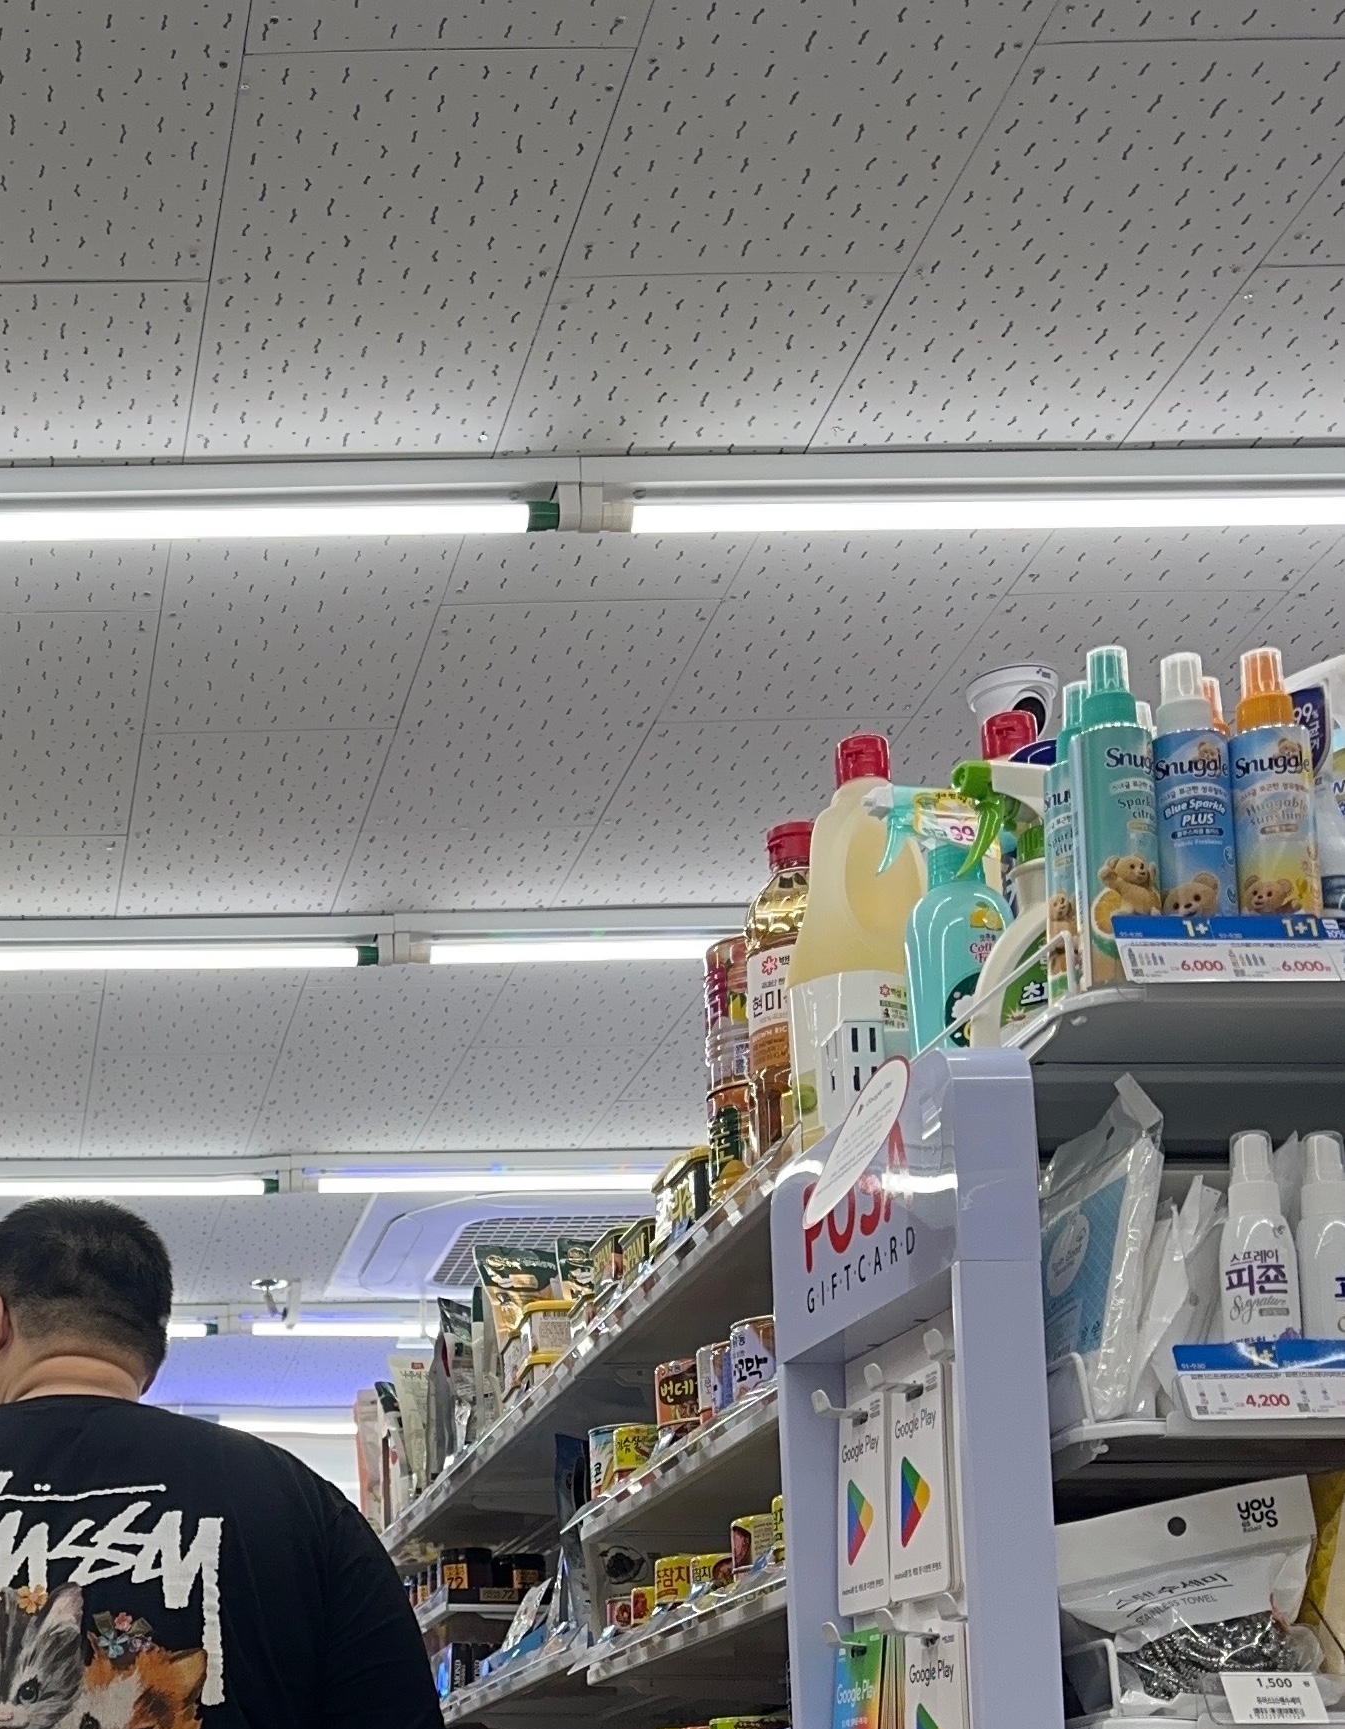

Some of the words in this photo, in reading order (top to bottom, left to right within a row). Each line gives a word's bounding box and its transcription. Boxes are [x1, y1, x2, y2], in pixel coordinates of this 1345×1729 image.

[1155, 749, 1229, 781] Snuggle
[1235, 749, 1310, 779] Snuggle
[1164, 801, 1189, 819] Blue
[1189, 799, 1226, 814] Sparkle
[1181, 812, 1215, 827] PLUS
[1282, 917, 1319, 938] 1+1
[1180, 959, 1224, 973] 6,000
[1281, 960, 1325, 973] 6,000
[1230, 1249, 1279, 1264] 스프레이
[1225, 1264, 1288, 1296] 피죤
[1245, 1393, 1291, 1408] 4,200
[895, 1418, 919, 1440] Google
[919, 1409, 936, 1431] Play
[841, 1443, 864, 1464] Google
[864, 1434, 879, 1454] Play
[1236, 1496, 1275, 1520] you
[1156, 1572, 1229, 1595] 수세미
[1181, 1593, 1219, 1609] TOWEL
[909, 1663, 937, 1687] Google
[937, 1659, 955, 1683] Play
[1256, 1677, 1293, 1689] 1,500
